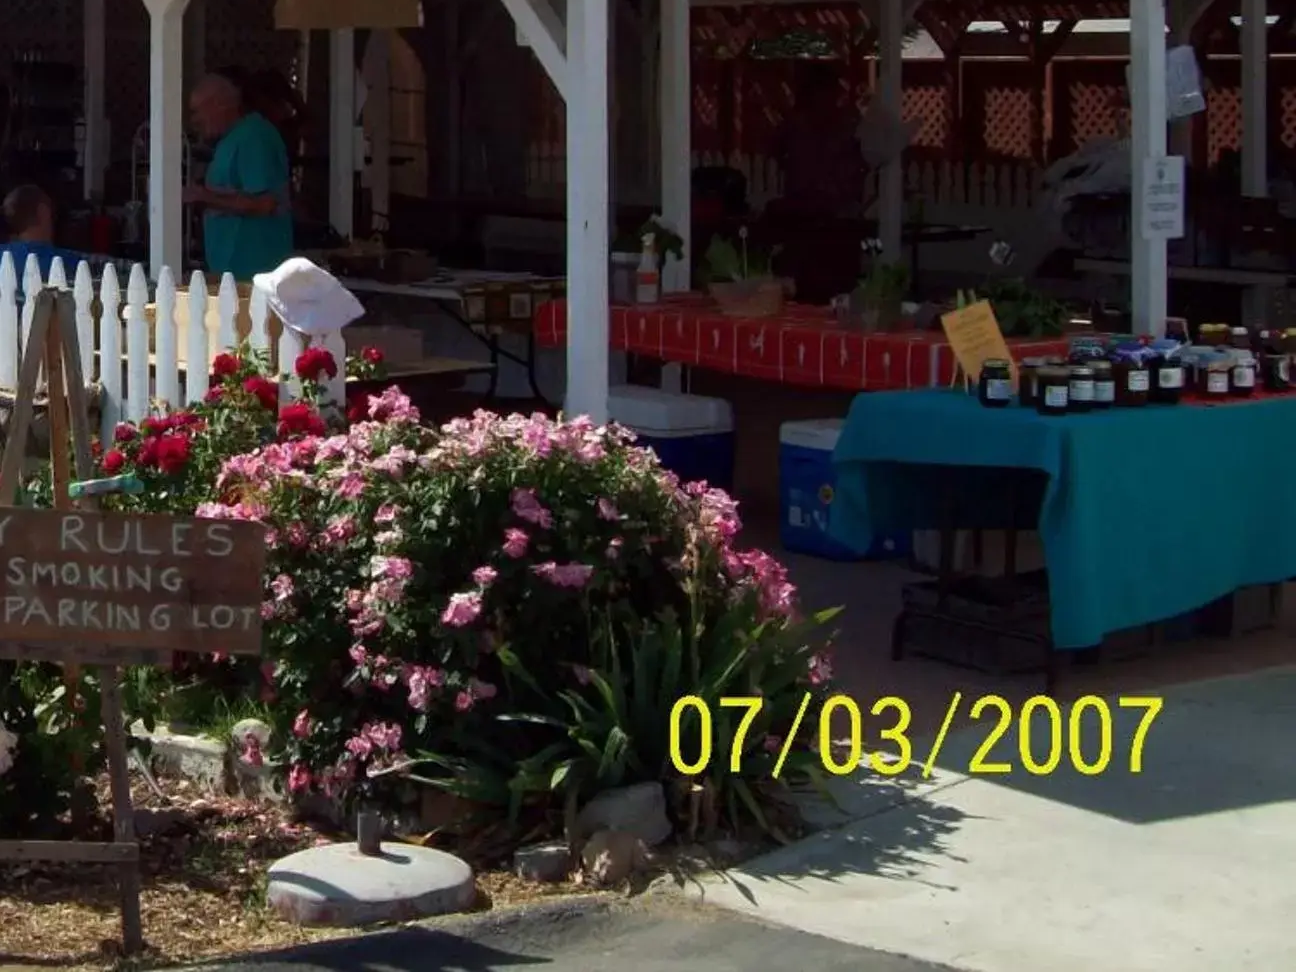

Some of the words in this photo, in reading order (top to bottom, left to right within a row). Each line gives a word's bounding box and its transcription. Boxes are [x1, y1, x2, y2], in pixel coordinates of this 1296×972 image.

[60, 514, 235, 557] RULES
[5, 557, 184, 592] SMOKING
[3, 595, 172, 631] PARKING
[191, 605, 257, 630] LOT
